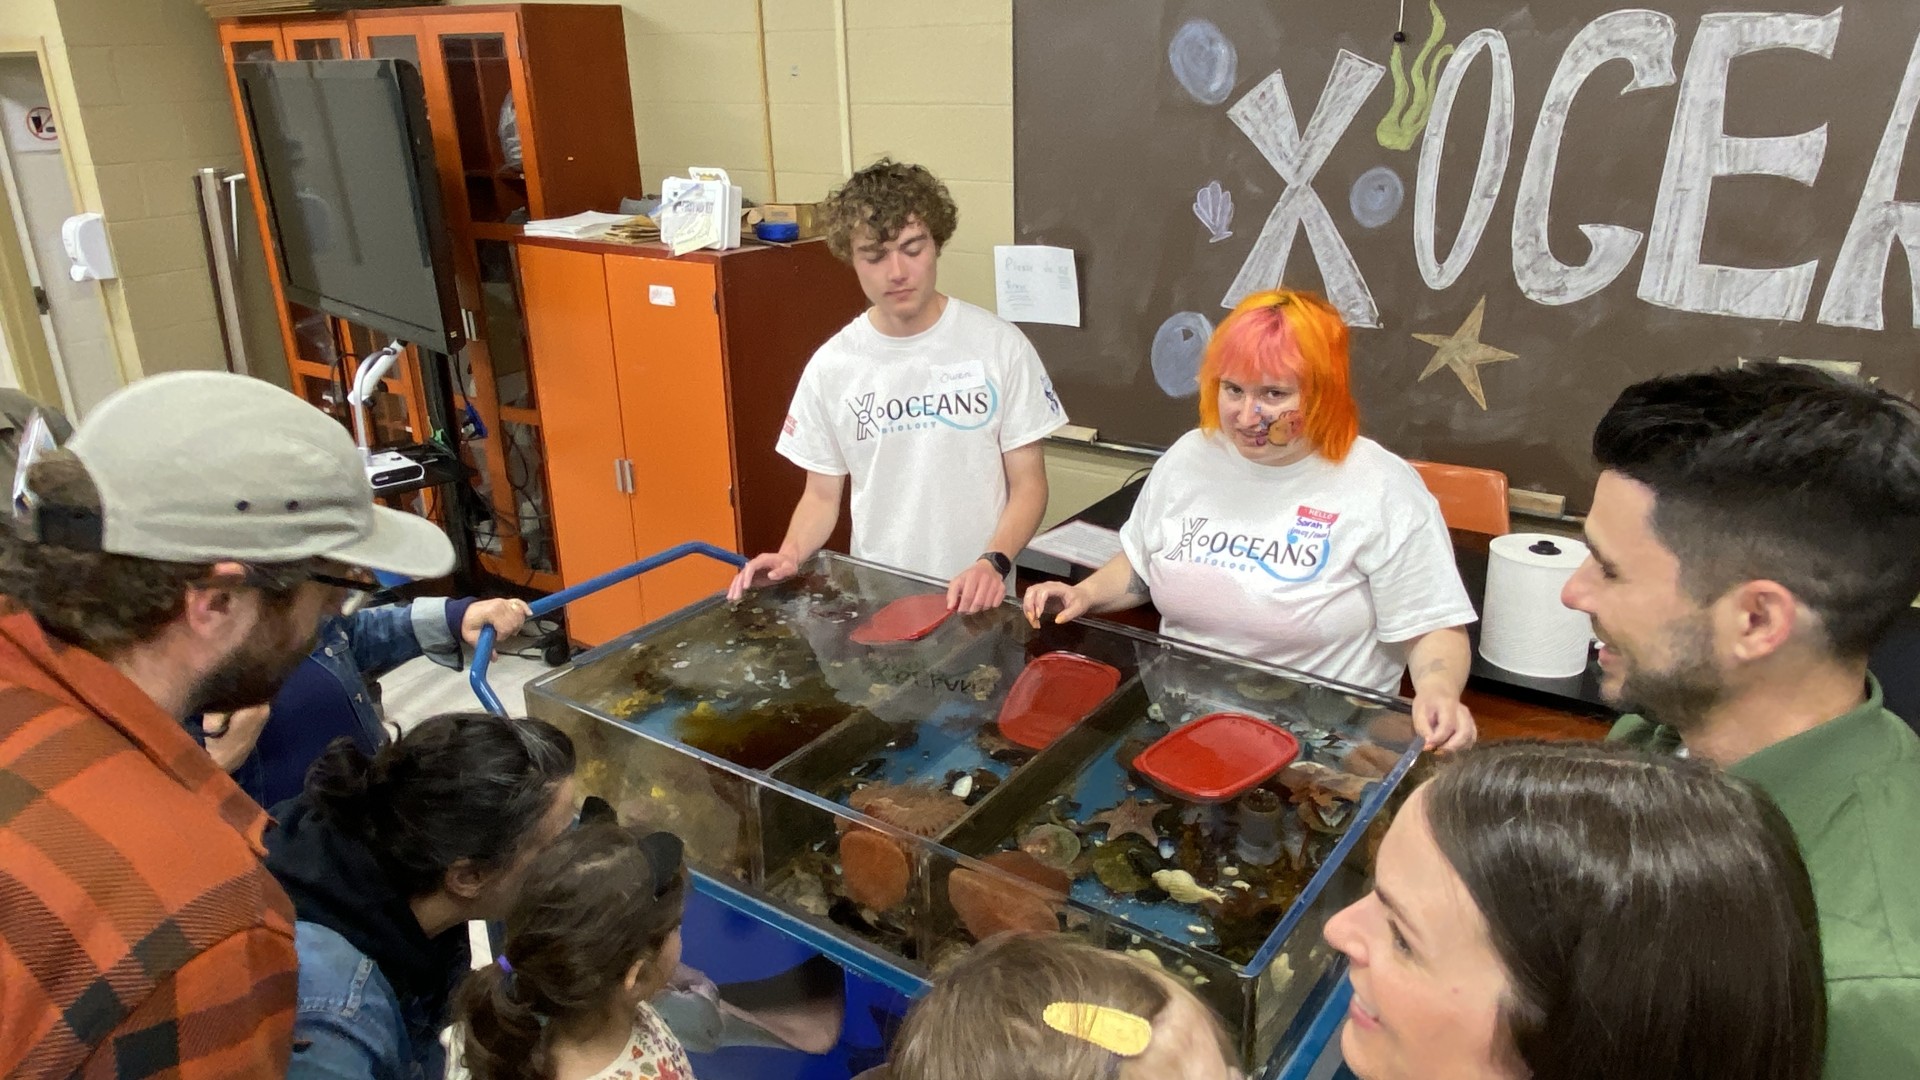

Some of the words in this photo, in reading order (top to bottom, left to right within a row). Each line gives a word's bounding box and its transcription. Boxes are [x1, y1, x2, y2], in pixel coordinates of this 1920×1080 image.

[939, 371, 973, 384] Owen
[886, 392, 988, 421] OCEANS
[882, 421, 937, 434] BIOLOGY
[1308, 508, 1333, 520] HELLO
[1296, 516, 1323, 529] Sarah
[1210, 531, 1319, 568] OCEANS
[1194, 555, 1257, 573] BIOLOGY
